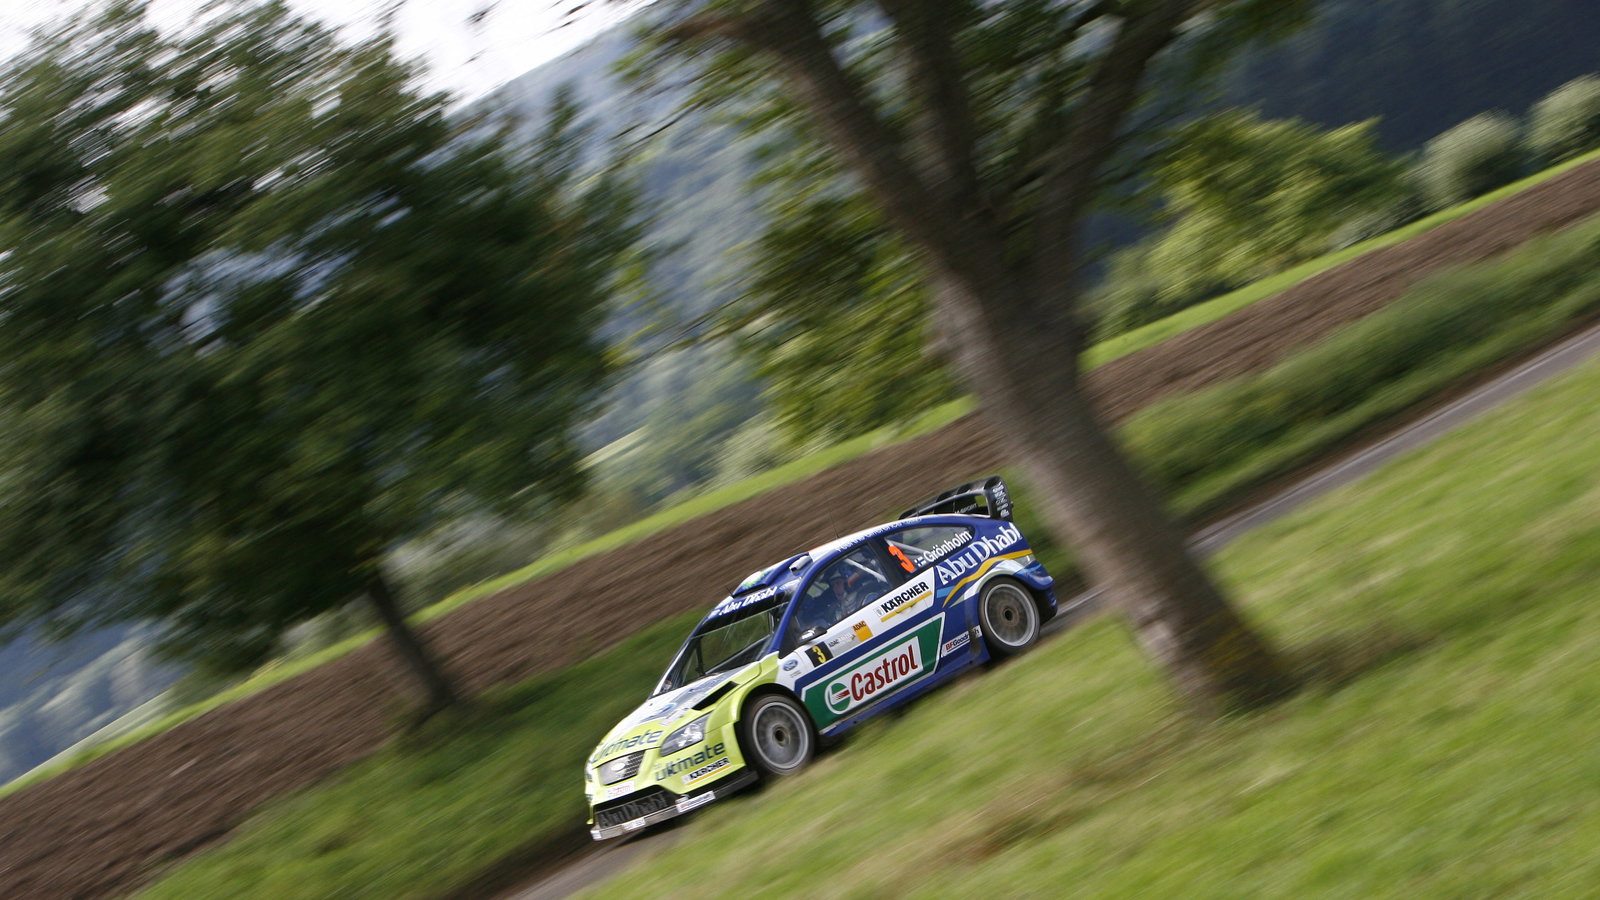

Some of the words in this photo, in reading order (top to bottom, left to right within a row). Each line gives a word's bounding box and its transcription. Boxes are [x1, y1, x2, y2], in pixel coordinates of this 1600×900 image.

[888, 545, 915, 573] 3
[923, 530, 973, 562] Grönholm
[935, 551, 978, 585] Abu
[967, 521, 1023, 563] Dhabi
[719, 600, 742, 616] Abu
[881, 581, 929, 614] KÄRCHER
[852, 620, 867, 633] ADAC
[812, 645, 827, 663] 3
[851, 644, 918, 701] Castrol
[655, 742, 725, 782] ultimate
